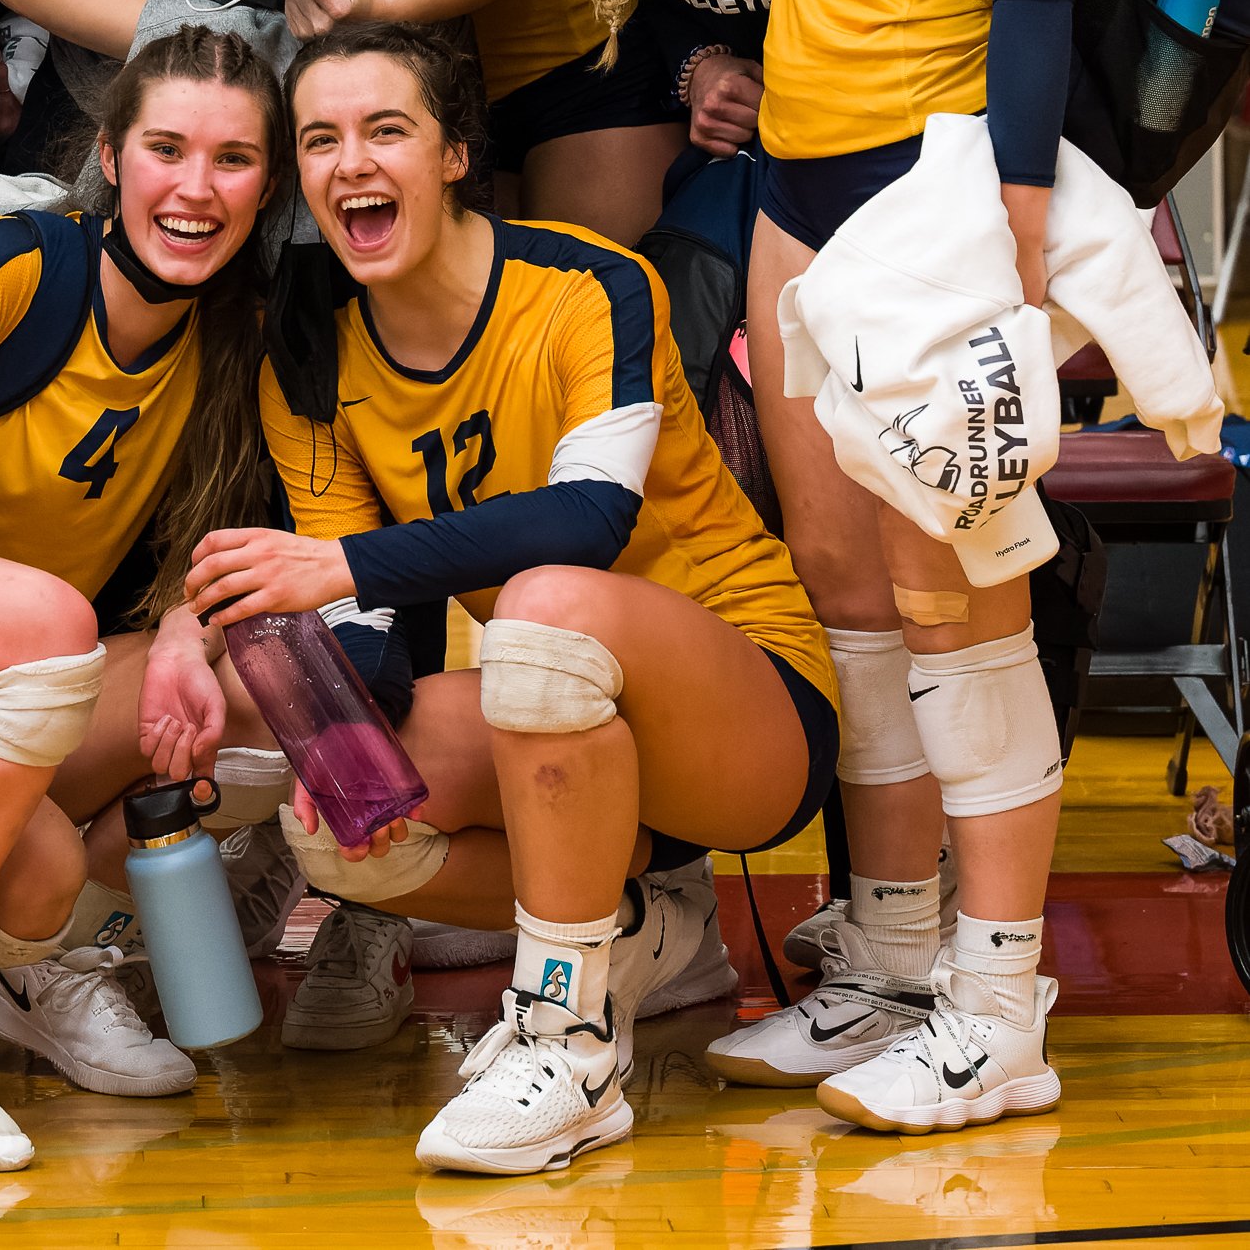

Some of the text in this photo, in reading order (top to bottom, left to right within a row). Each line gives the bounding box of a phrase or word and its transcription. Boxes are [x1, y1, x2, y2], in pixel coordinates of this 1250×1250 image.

[58, 405, 141, 499] 4
[412, 409, 510, 517] 12
[954, 378, 989, 530] ROADRUNNER
[995, 536, 1031, 557] Hydro Flask
